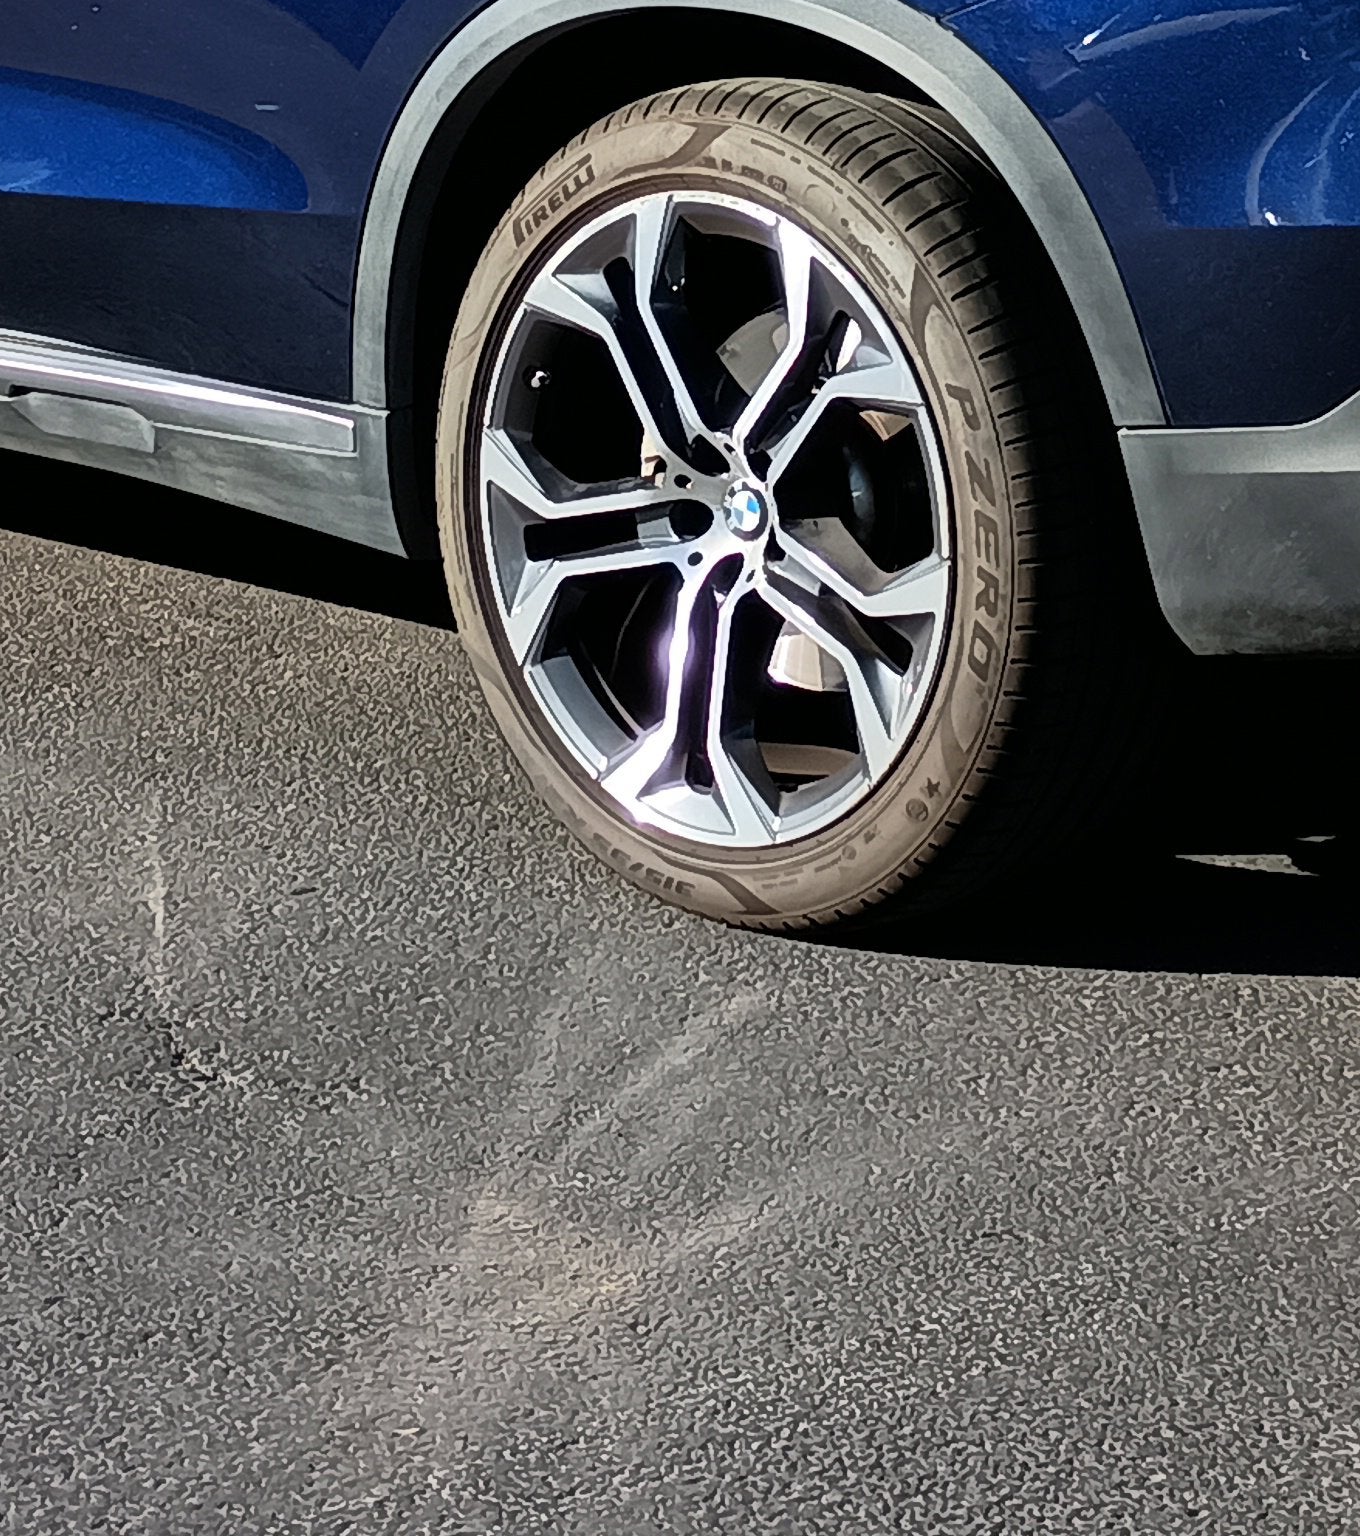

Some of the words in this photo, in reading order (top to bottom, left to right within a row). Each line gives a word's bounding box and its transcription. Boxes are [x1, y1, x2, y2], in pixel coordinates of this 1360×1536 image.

[513, 152, 596, 248] PIRELLI
[945, 383, 981, 431] P
[964, 450, 1001, 683] ZERO
